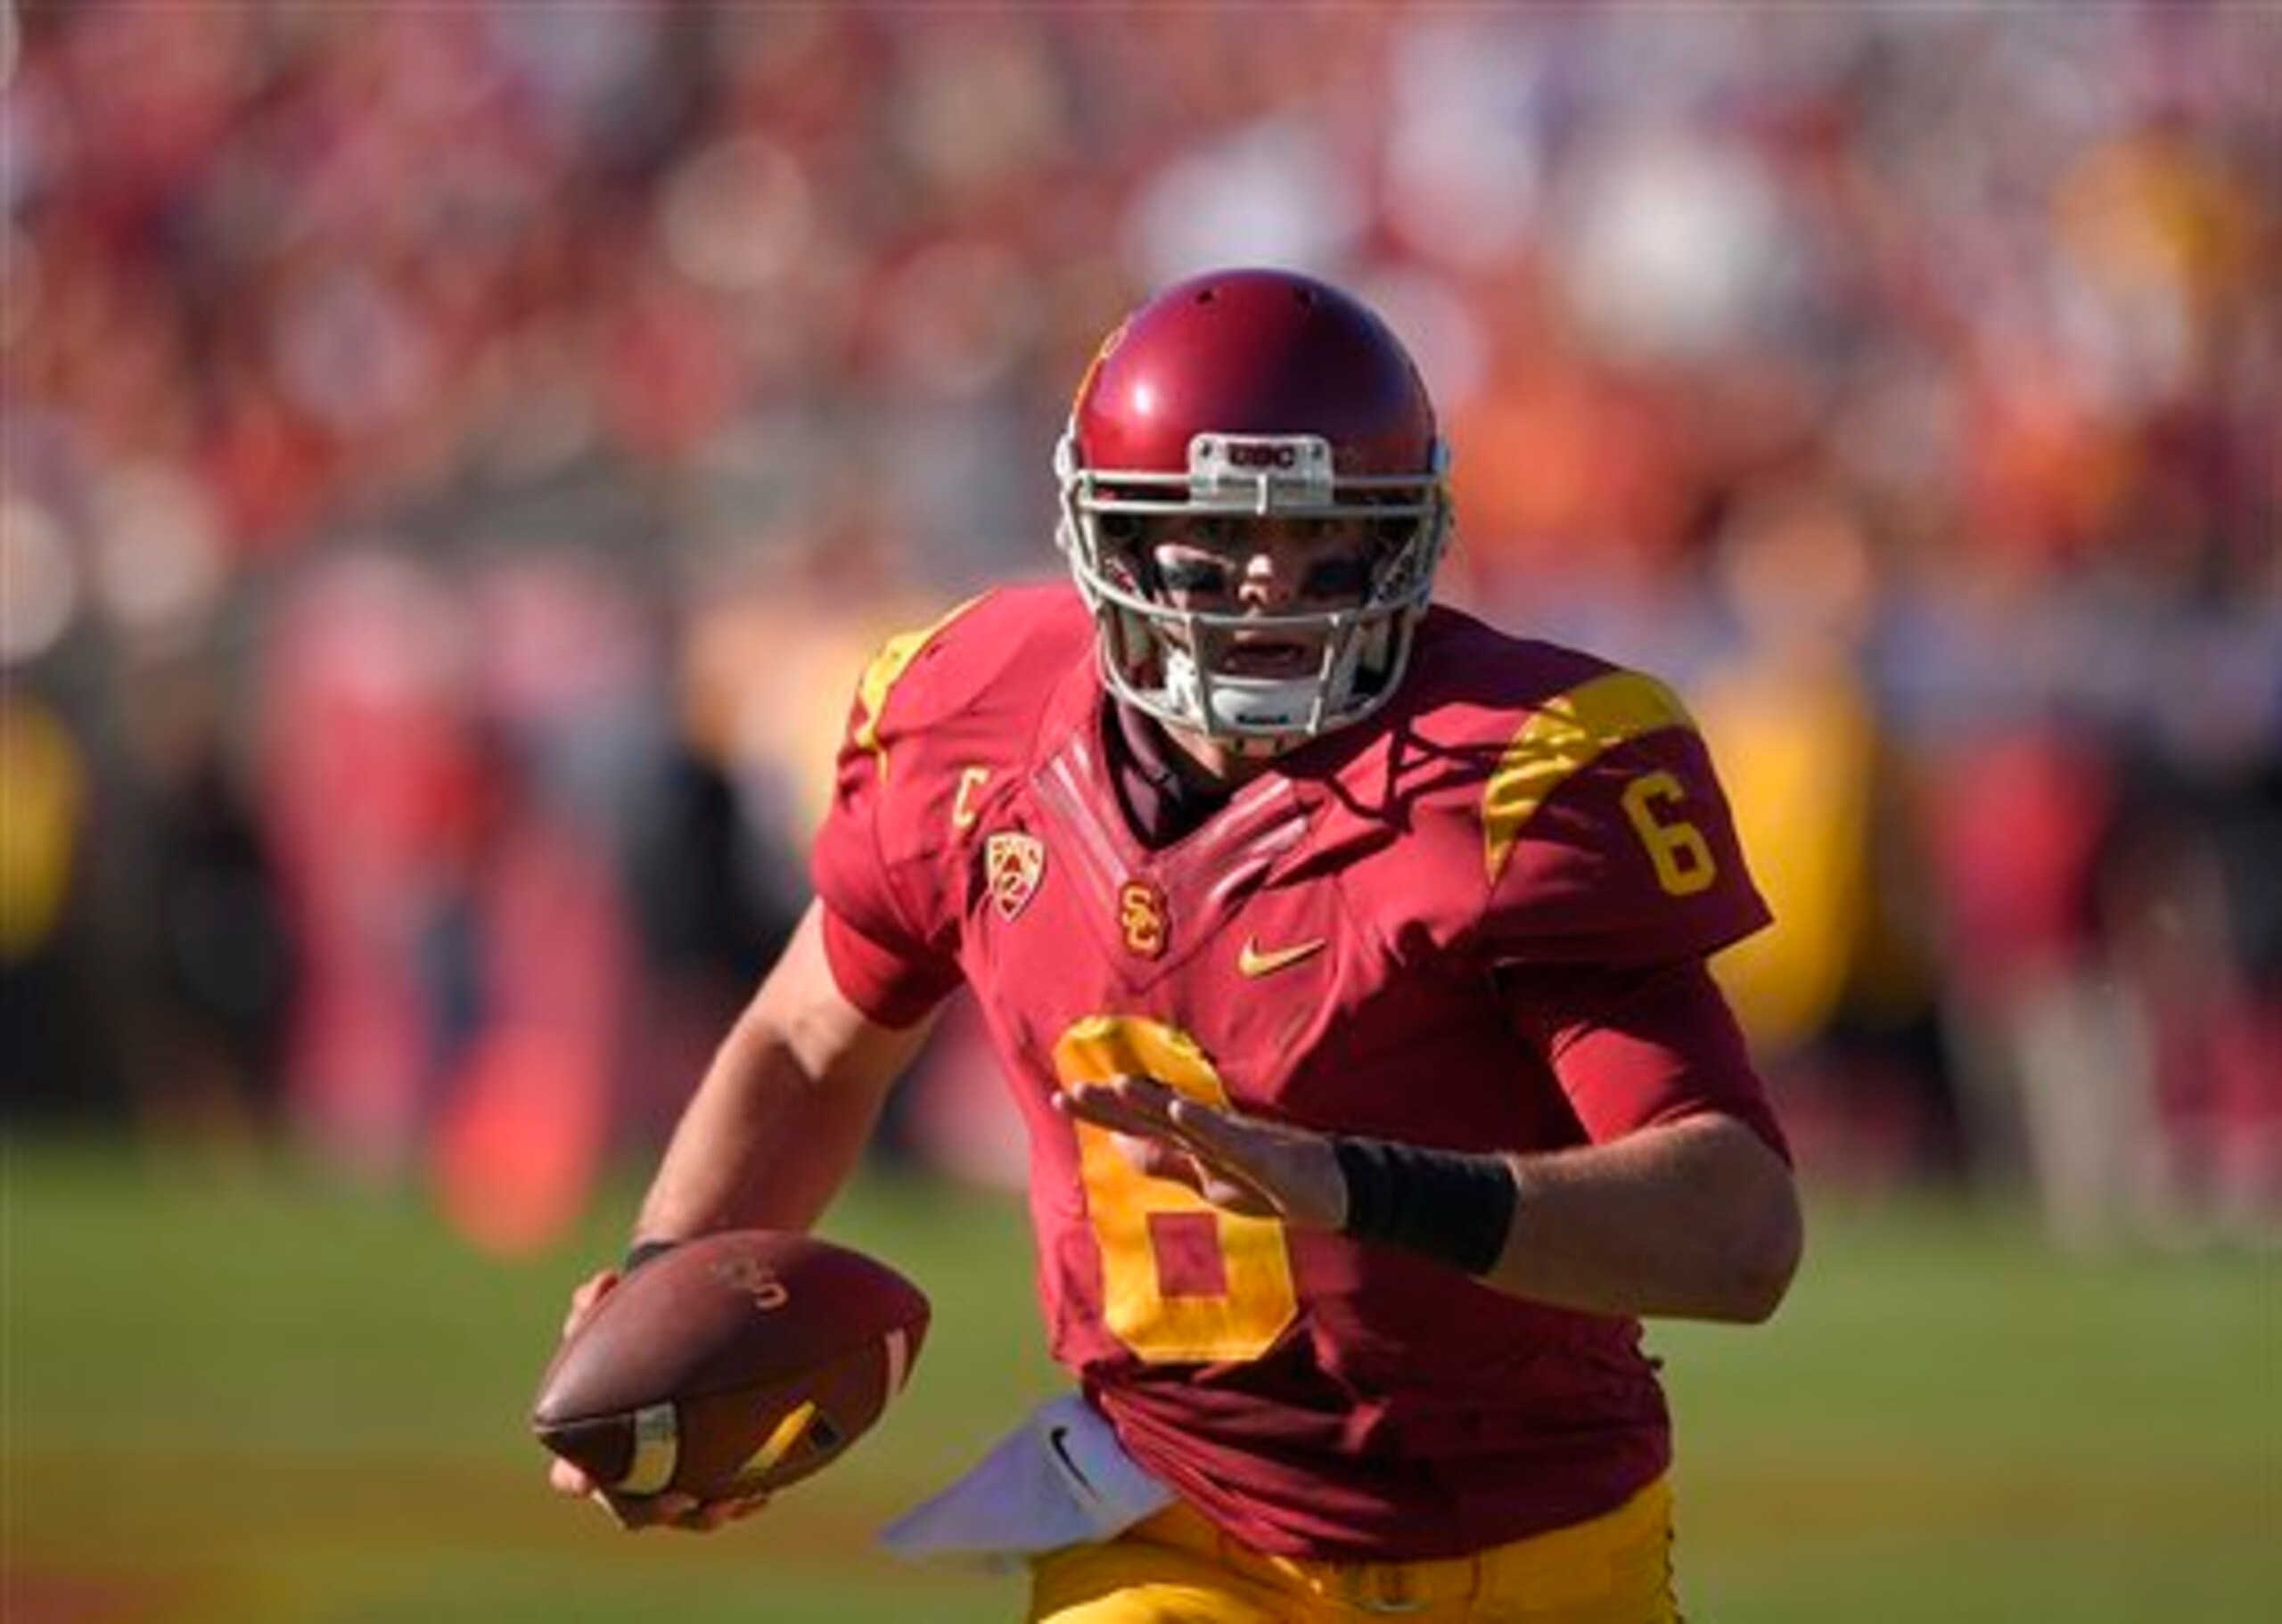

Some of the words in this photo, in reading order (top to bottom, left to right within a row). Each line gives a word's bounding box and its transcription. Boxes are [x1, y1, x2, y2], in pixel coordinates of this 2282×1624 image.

[953, 767, 989, 826] C
[1621, 770, 1717, 896] 6
[1054, 1014, 1298, 1362] 6
